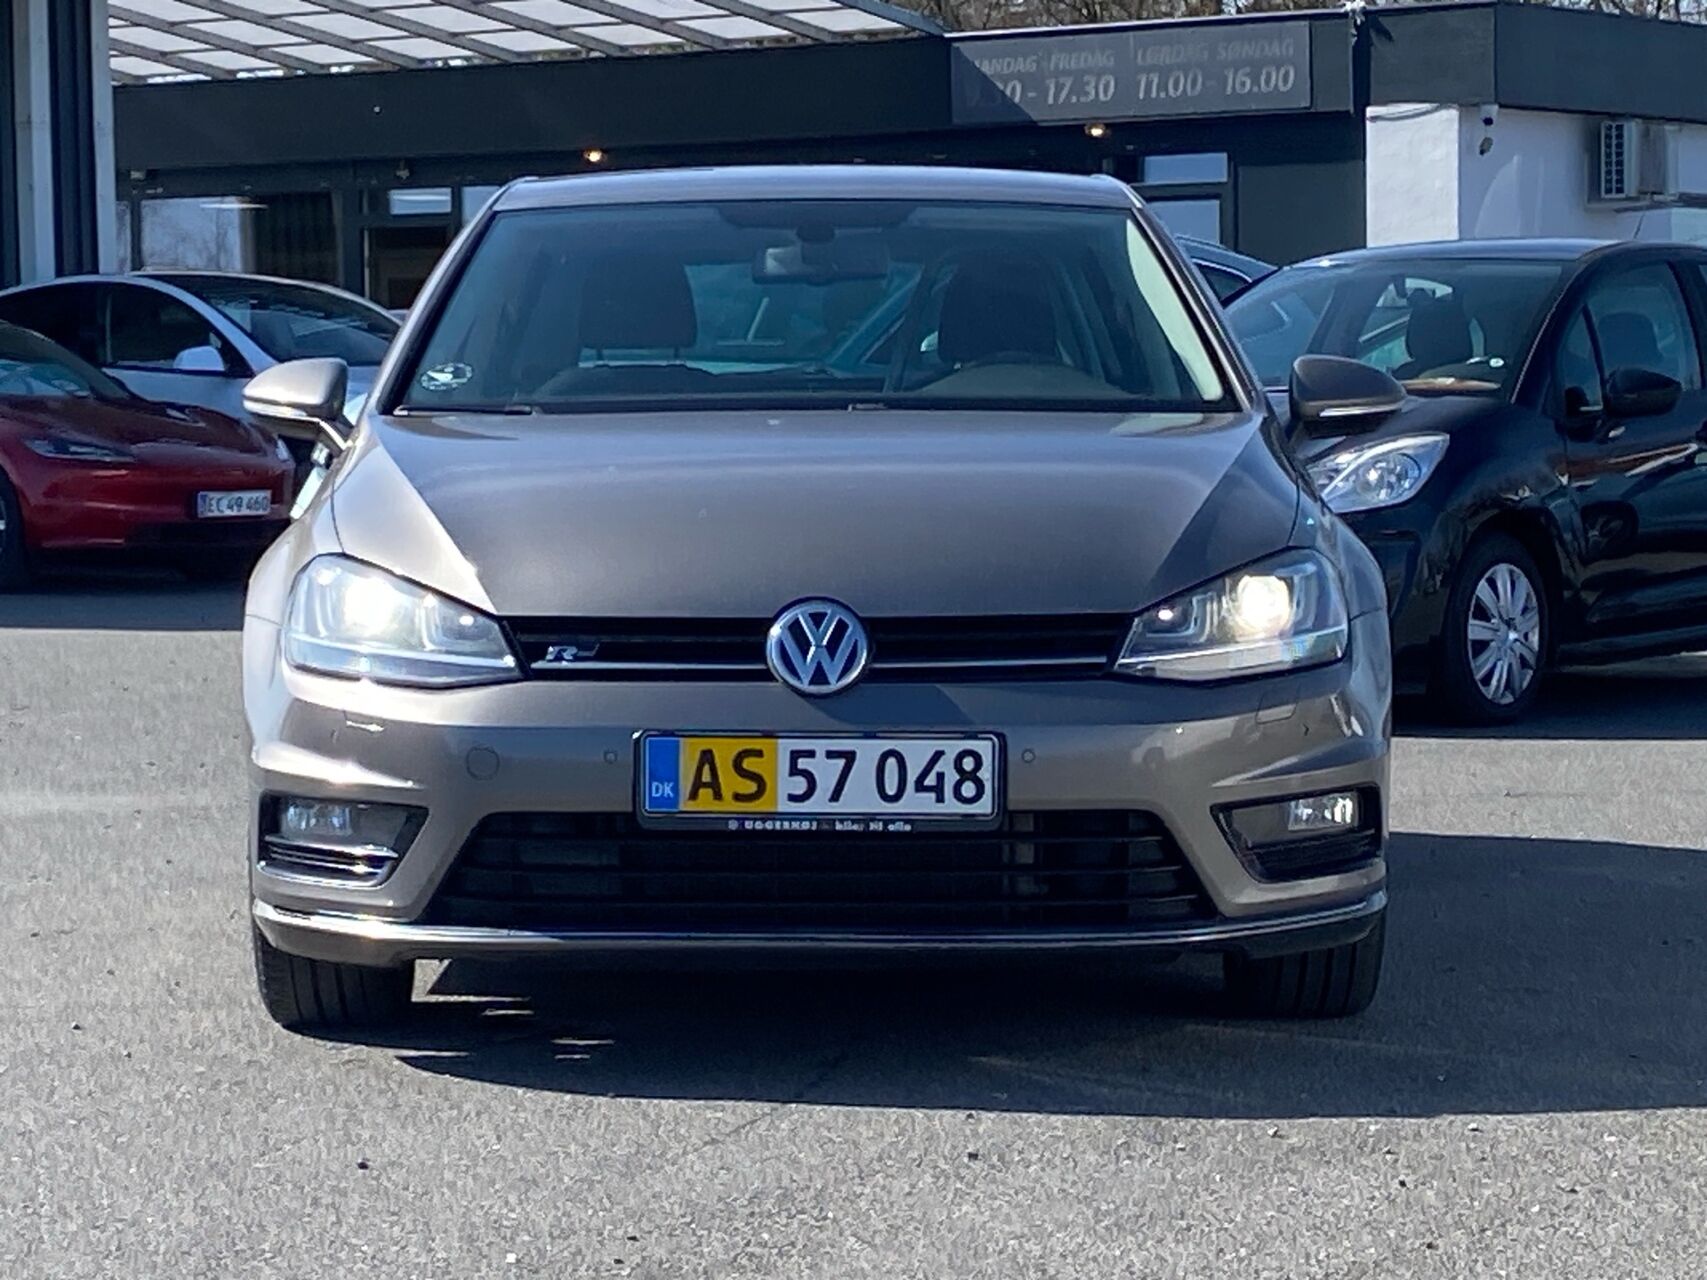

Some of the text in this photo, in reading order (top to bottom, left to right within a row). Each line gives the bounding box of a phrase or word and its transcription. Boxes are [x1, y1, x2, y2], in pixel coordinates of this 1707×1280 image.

[1049, 49, 1115, 71] FREDAG
[1217, 38, 1294, 61] SØNDAG
[1046, 74, 1115, 105] 17.30
[1137, 67, 1203, 100] 11.00
[1224, 64, 1295, 95] 16.00
[651, 781, 675, 798] DK
[687, 748, 986, 804] AS 57 048
